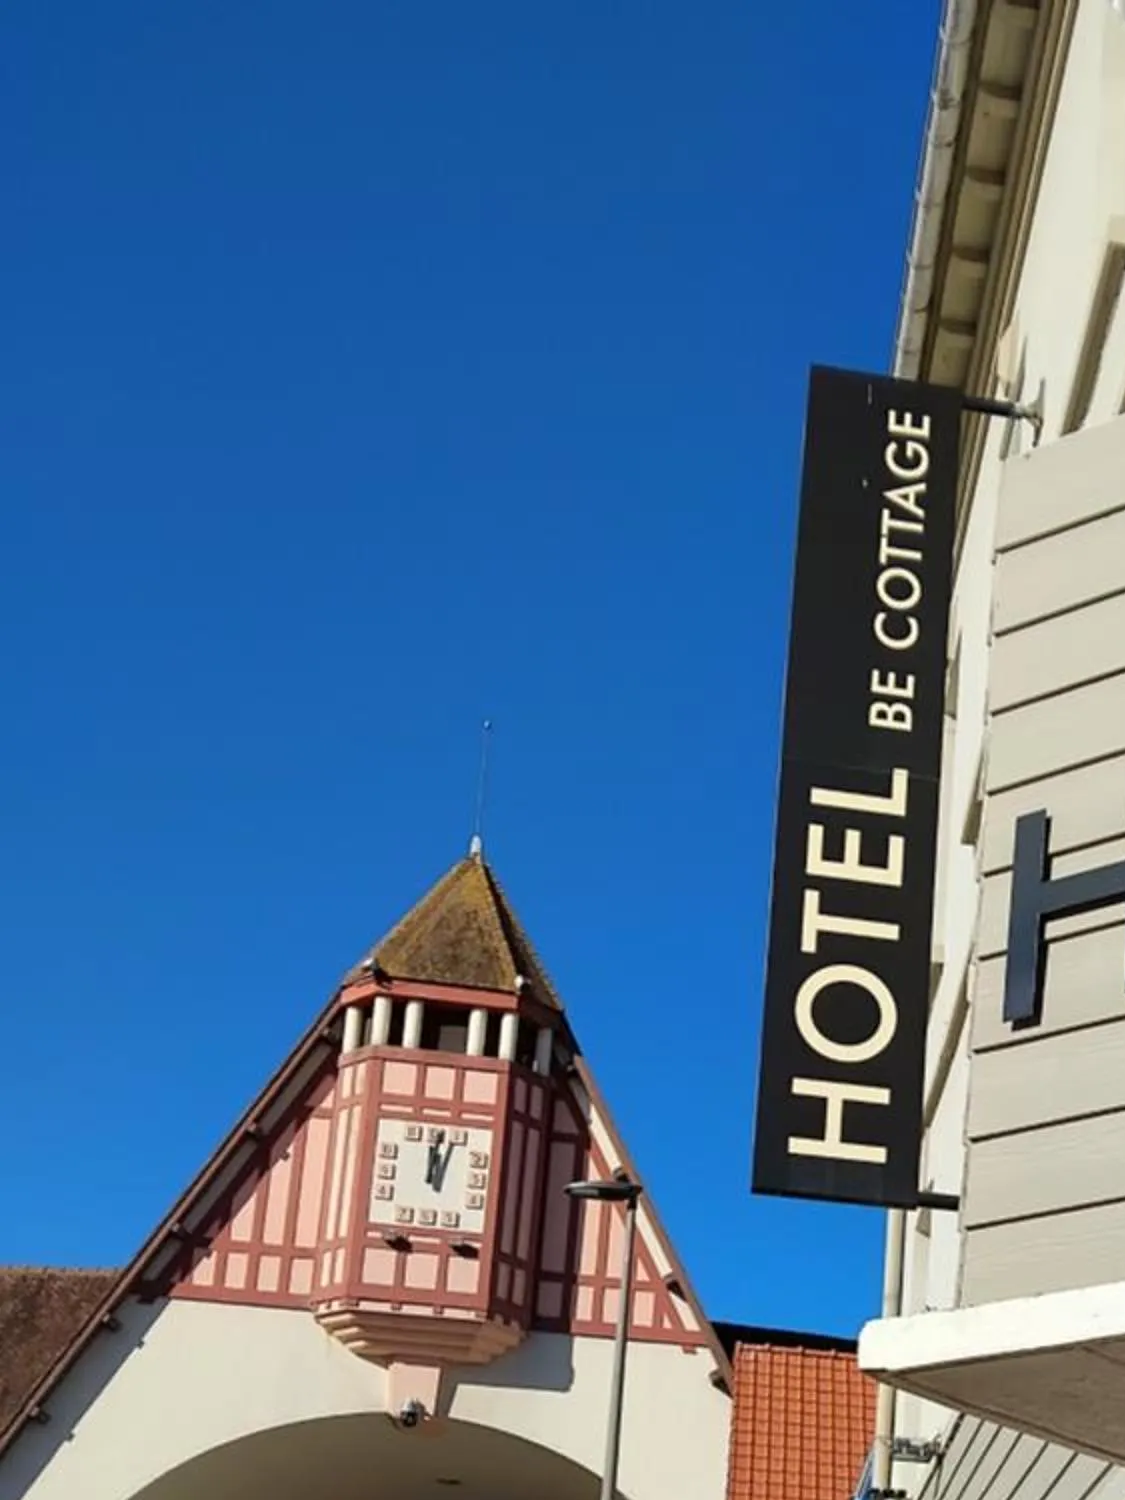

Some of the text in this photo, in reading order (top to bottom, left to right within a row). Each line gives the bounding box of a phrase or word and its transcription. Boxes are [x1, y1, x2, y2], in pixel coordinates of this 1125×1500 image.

[788, 409, 931, 1163] HOTEL BE COTTAGE
